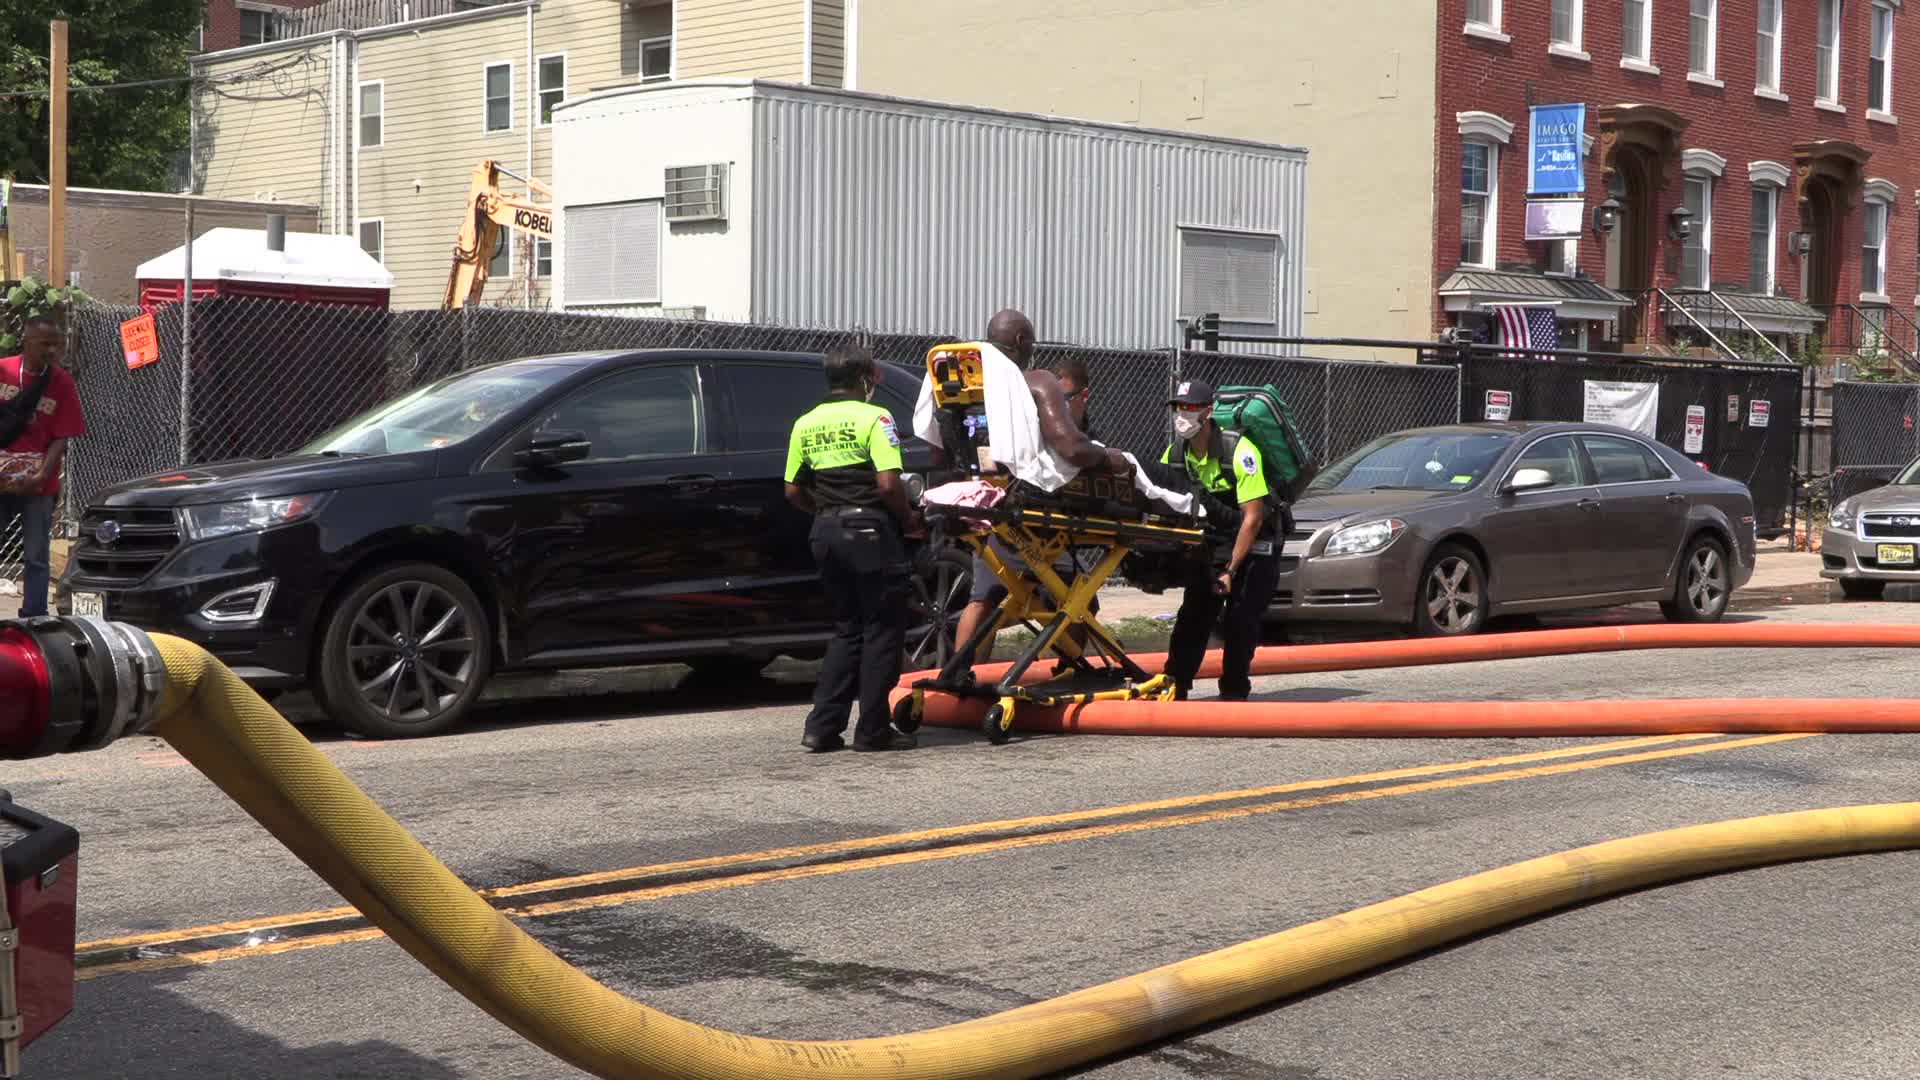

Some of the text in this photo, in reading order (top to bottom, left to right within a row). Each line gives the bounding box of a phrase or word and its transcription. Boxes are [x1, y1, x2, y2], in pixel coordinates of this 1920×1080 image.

[1537, 122, 1577, 137] IMAGO
[123, 319, 151, 339] SIDEWALK
[128, 335, 151, 352] CLOSED
[800, 428, 857, 448] EMS
